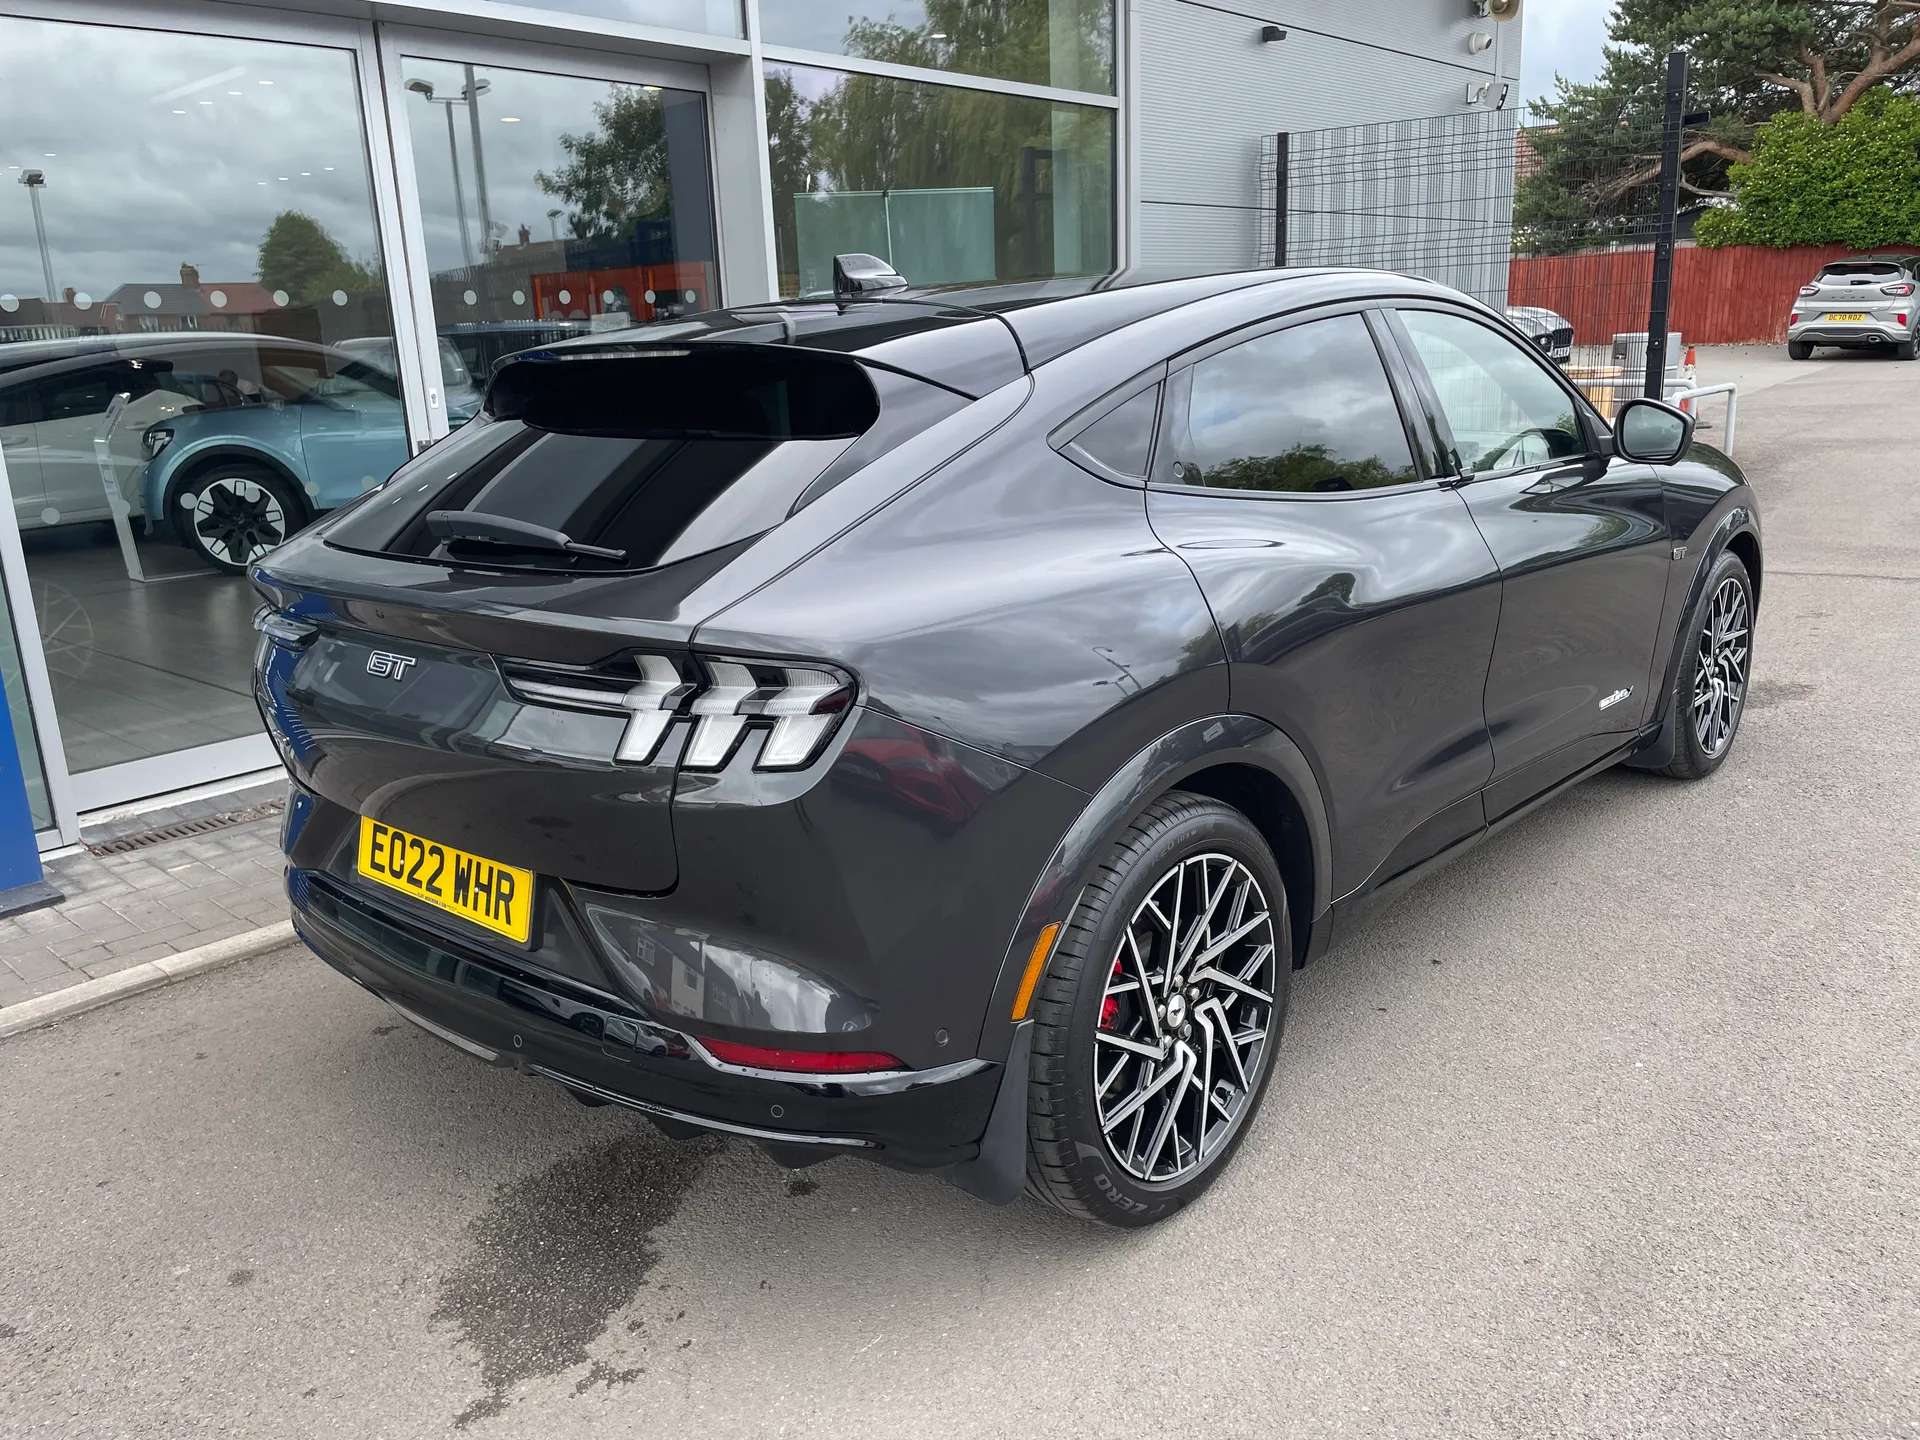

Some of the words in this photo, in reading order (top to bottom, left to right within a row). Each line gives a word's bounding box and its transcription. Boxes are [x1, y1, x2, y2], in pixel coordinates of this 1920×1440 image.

[1673, 546, 1688, 560] GT
[366, 650, 416, 681] GT
[370, 822, 445, 897] EO22
[453, 853, 515, 926] WHR
[1093, 1173, 1148, 1215] ZERO
